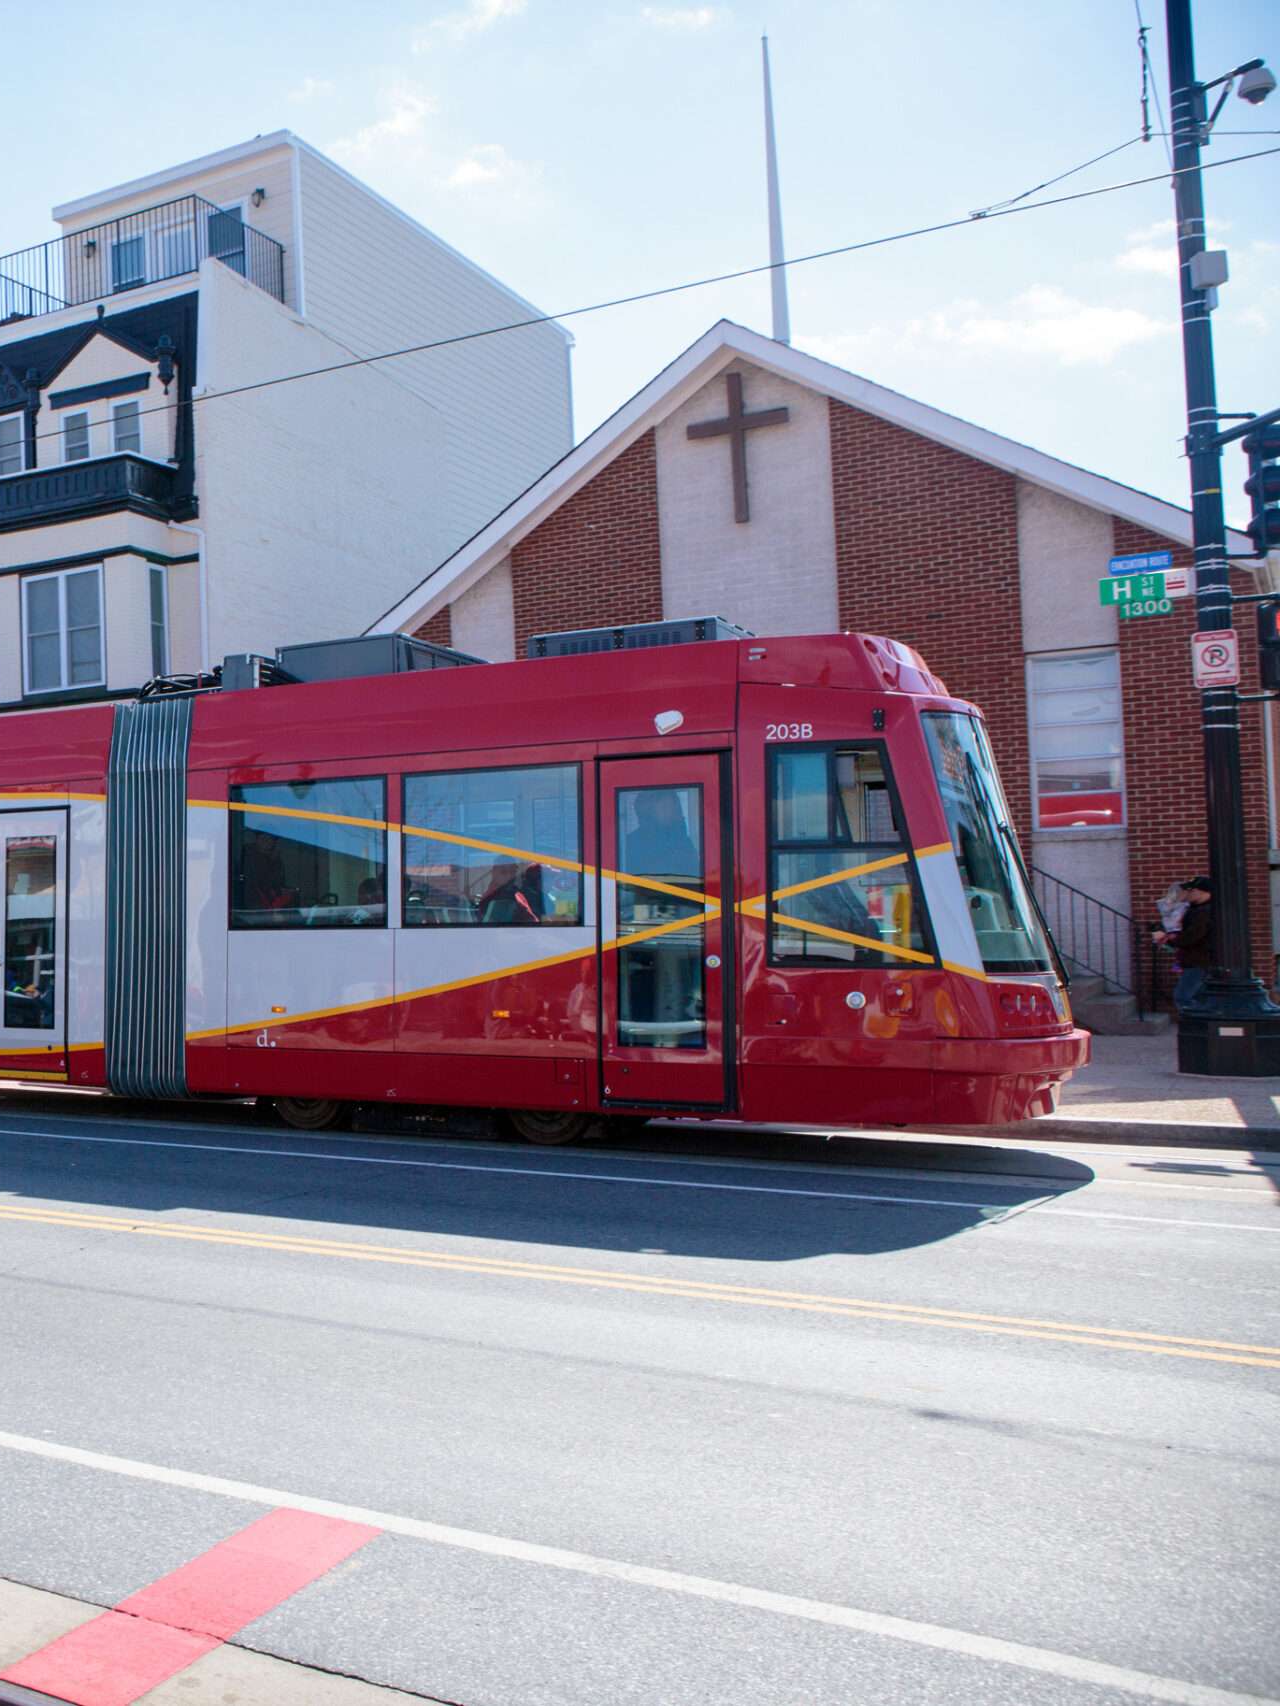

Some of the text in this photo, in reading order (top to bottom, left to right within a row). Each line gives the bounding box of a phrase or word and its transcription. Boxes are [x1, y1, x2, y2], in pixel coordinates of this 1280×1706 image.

[1113, 576, 1154, 600] H ST
[1123, 599, 1171, 617] 1300
[766, 723, 813, 740] 203B
